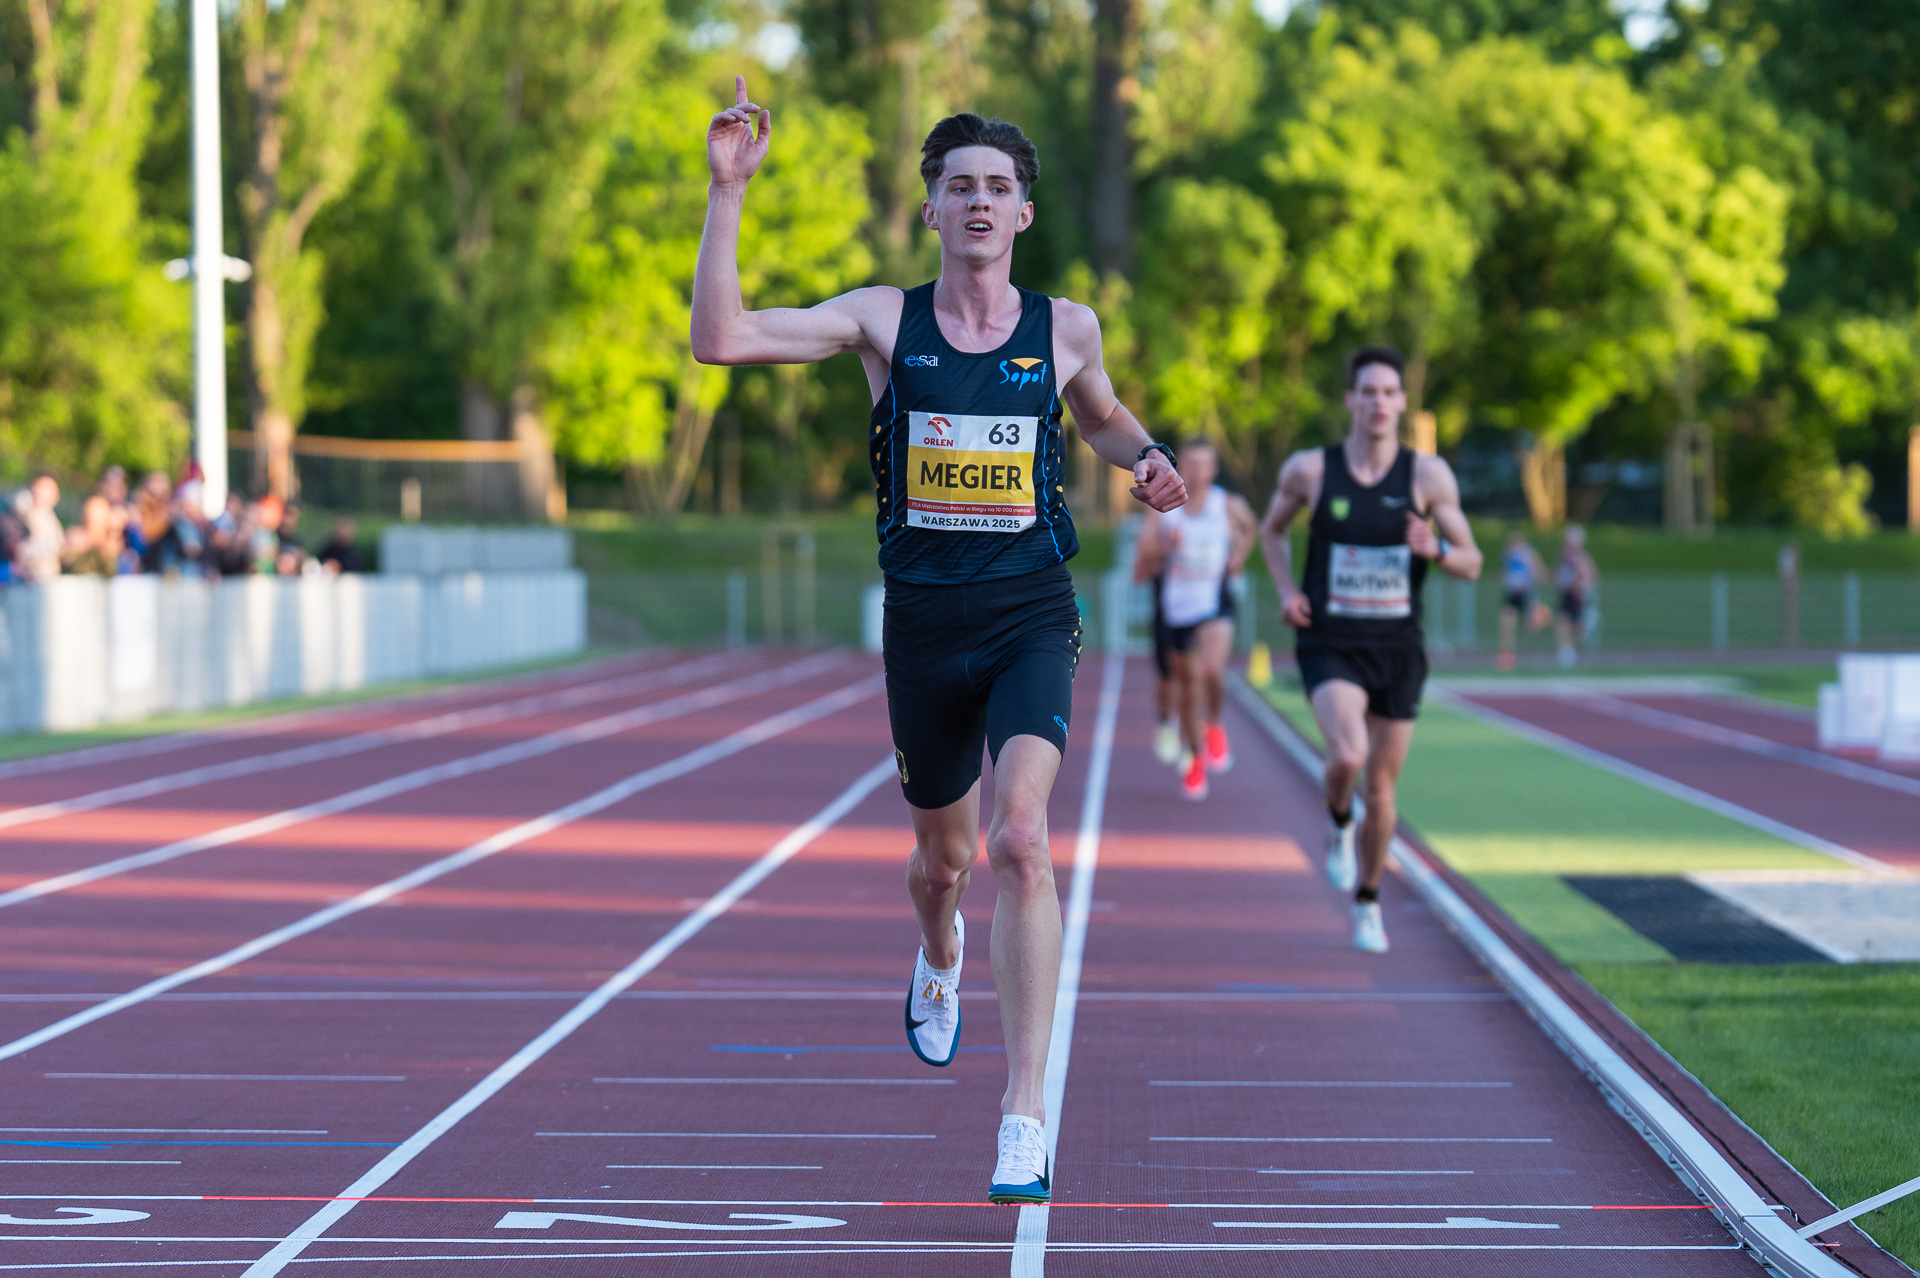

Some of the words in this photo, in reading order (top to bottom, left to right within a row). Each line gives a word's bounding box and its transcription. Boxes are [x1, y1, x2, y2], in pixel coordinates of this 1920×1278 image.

[1000, 360, 1047, 391] Sopot
[923, 437, 954, 447] ORLEN
[988, 423, 1020, 445] 63
[920, 461, 1023, 490] MEGIER
[921, 515, 989, 528] WARSZAWA
[991, 519, 1021, 529] 2025
